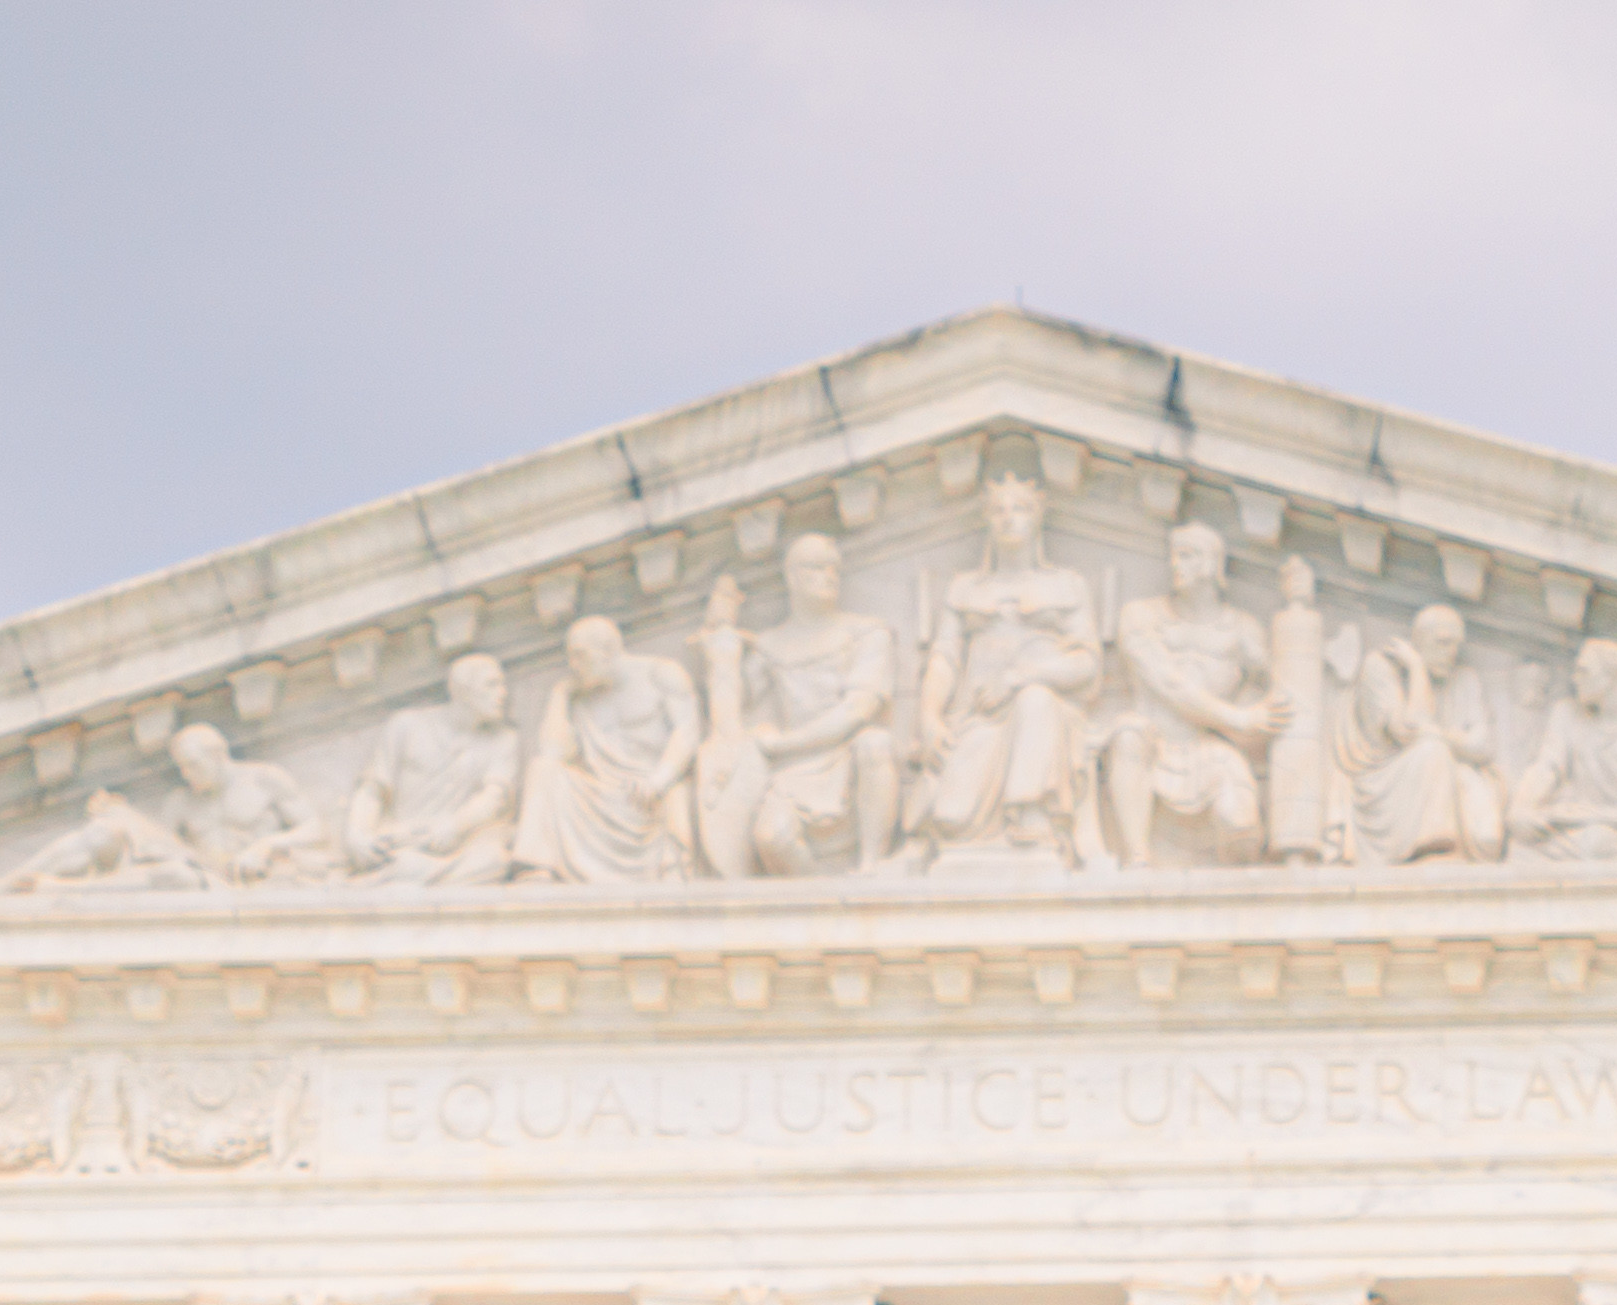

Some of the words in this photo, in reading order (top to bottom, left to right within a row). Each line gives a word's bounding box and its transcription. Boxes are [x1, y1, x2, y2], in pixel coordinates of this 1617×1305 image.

[385, 1075, 687, 1148] EQUAL
[710, 1062, 1069, 1136] JUSTICE
[1119, 1059, 1432, 1129] UNDER
